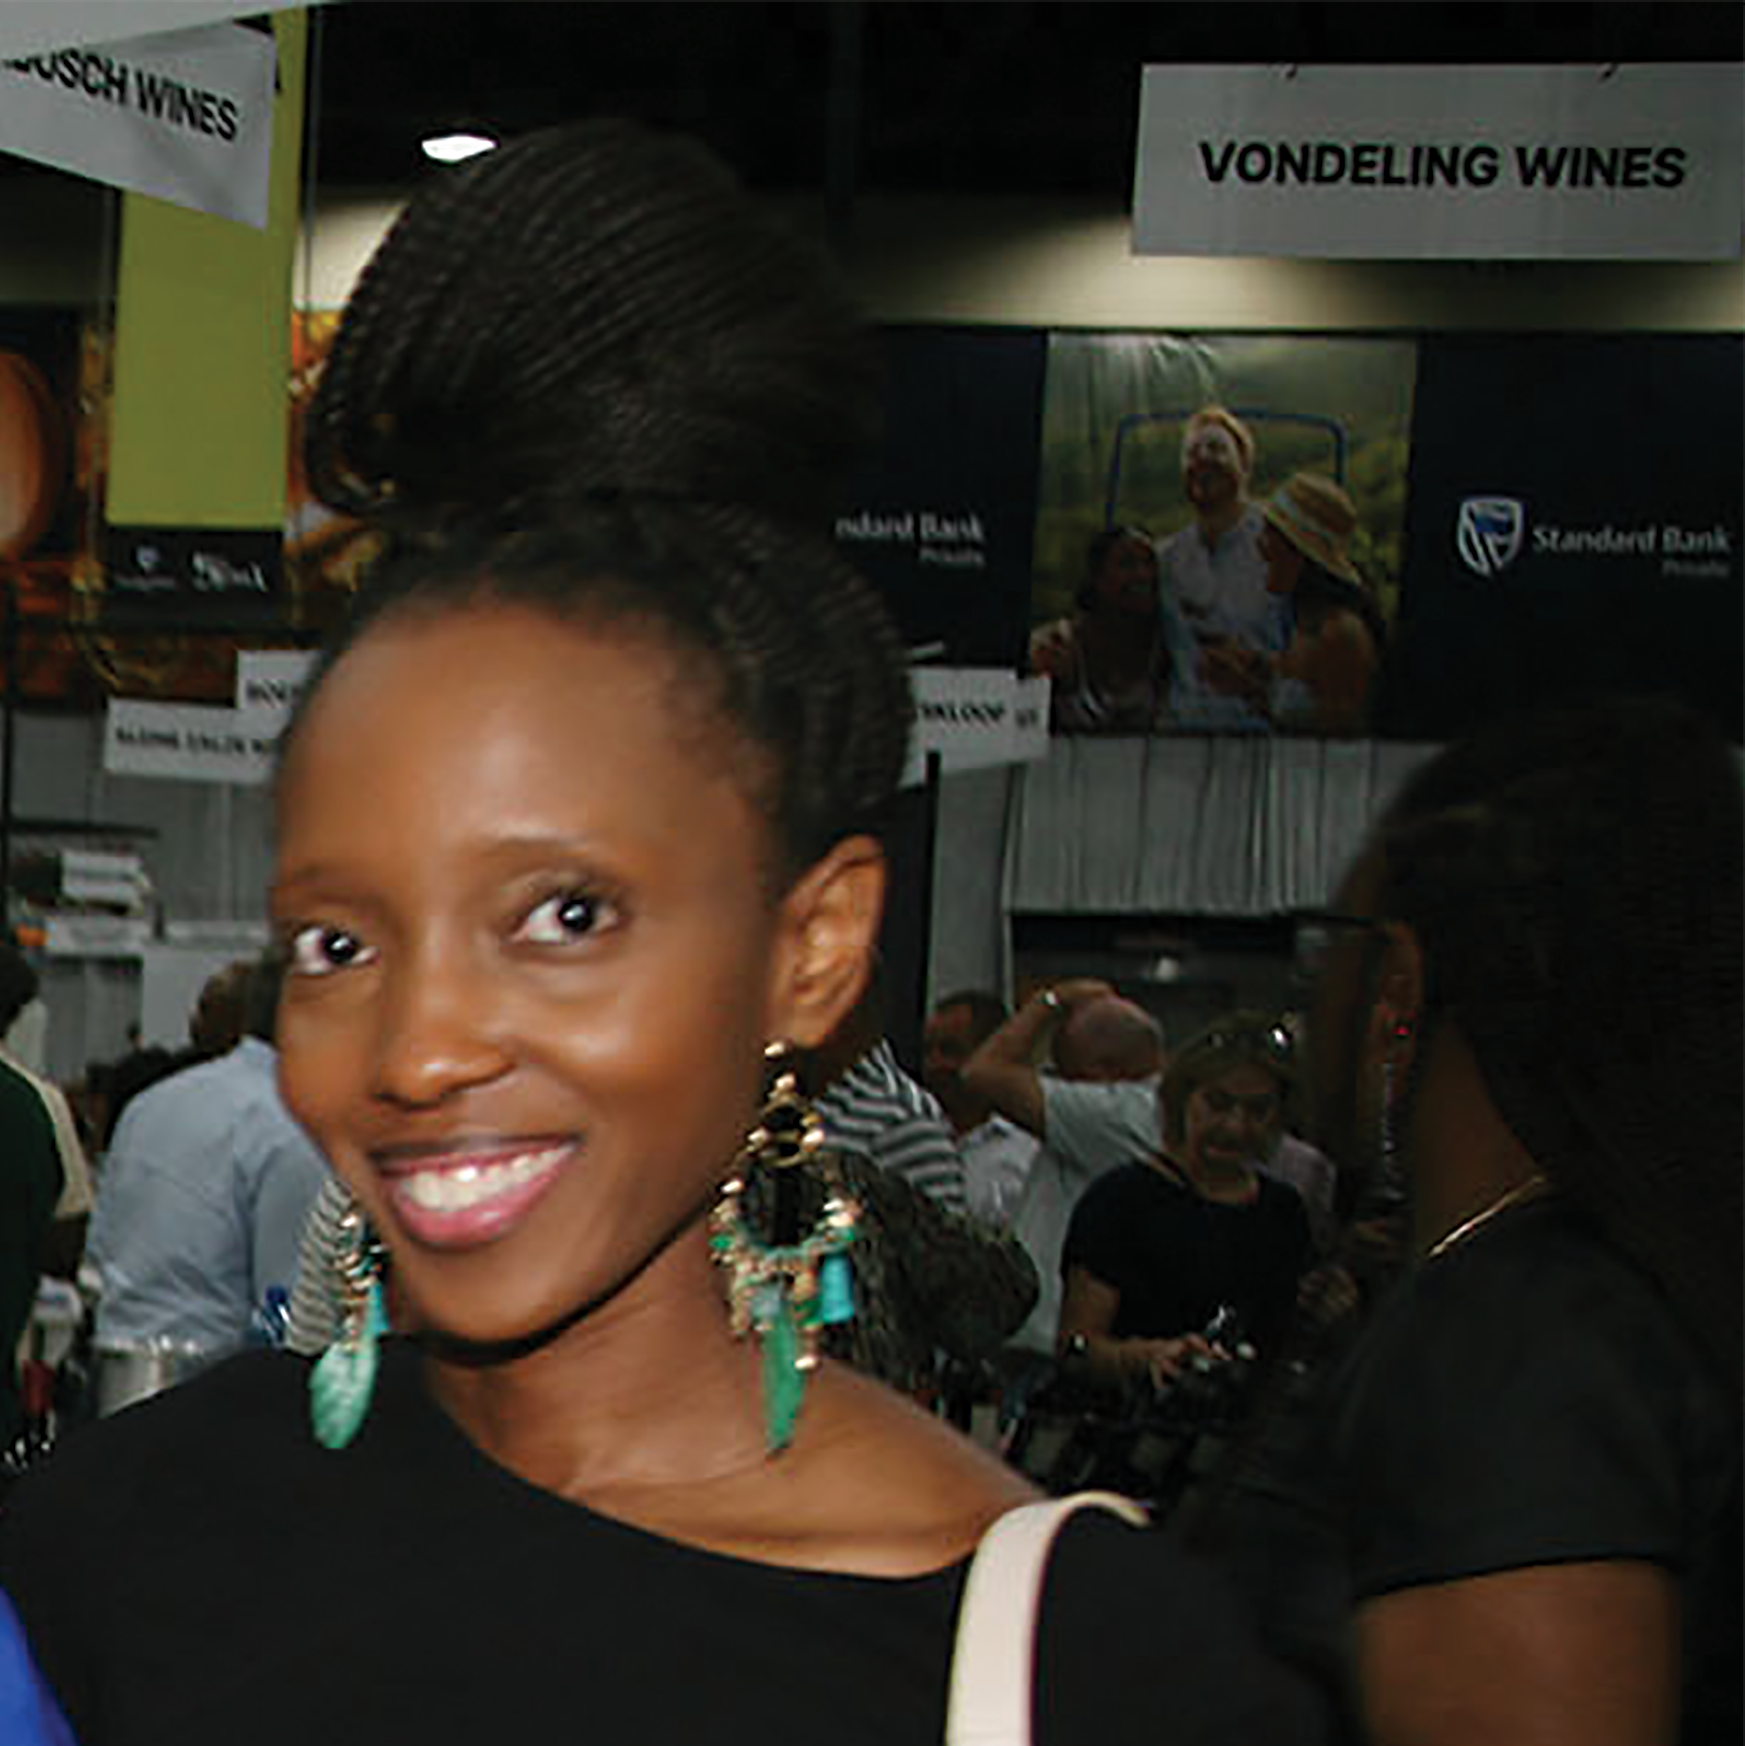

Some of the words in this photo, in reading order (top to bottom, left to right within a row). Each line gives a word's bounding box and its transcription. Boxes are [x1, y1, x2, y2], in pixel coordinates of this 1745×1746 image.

[136, 70, 240, 141] WINES
[1200, 141, 1500, 189] VONDELING
[1516, 145, 1687, 190] WINES
[918, 510, 987, 544] Bank
[1532, 524, 1656, 555] Standard
[1661, 524, 1732, 555] Bank
